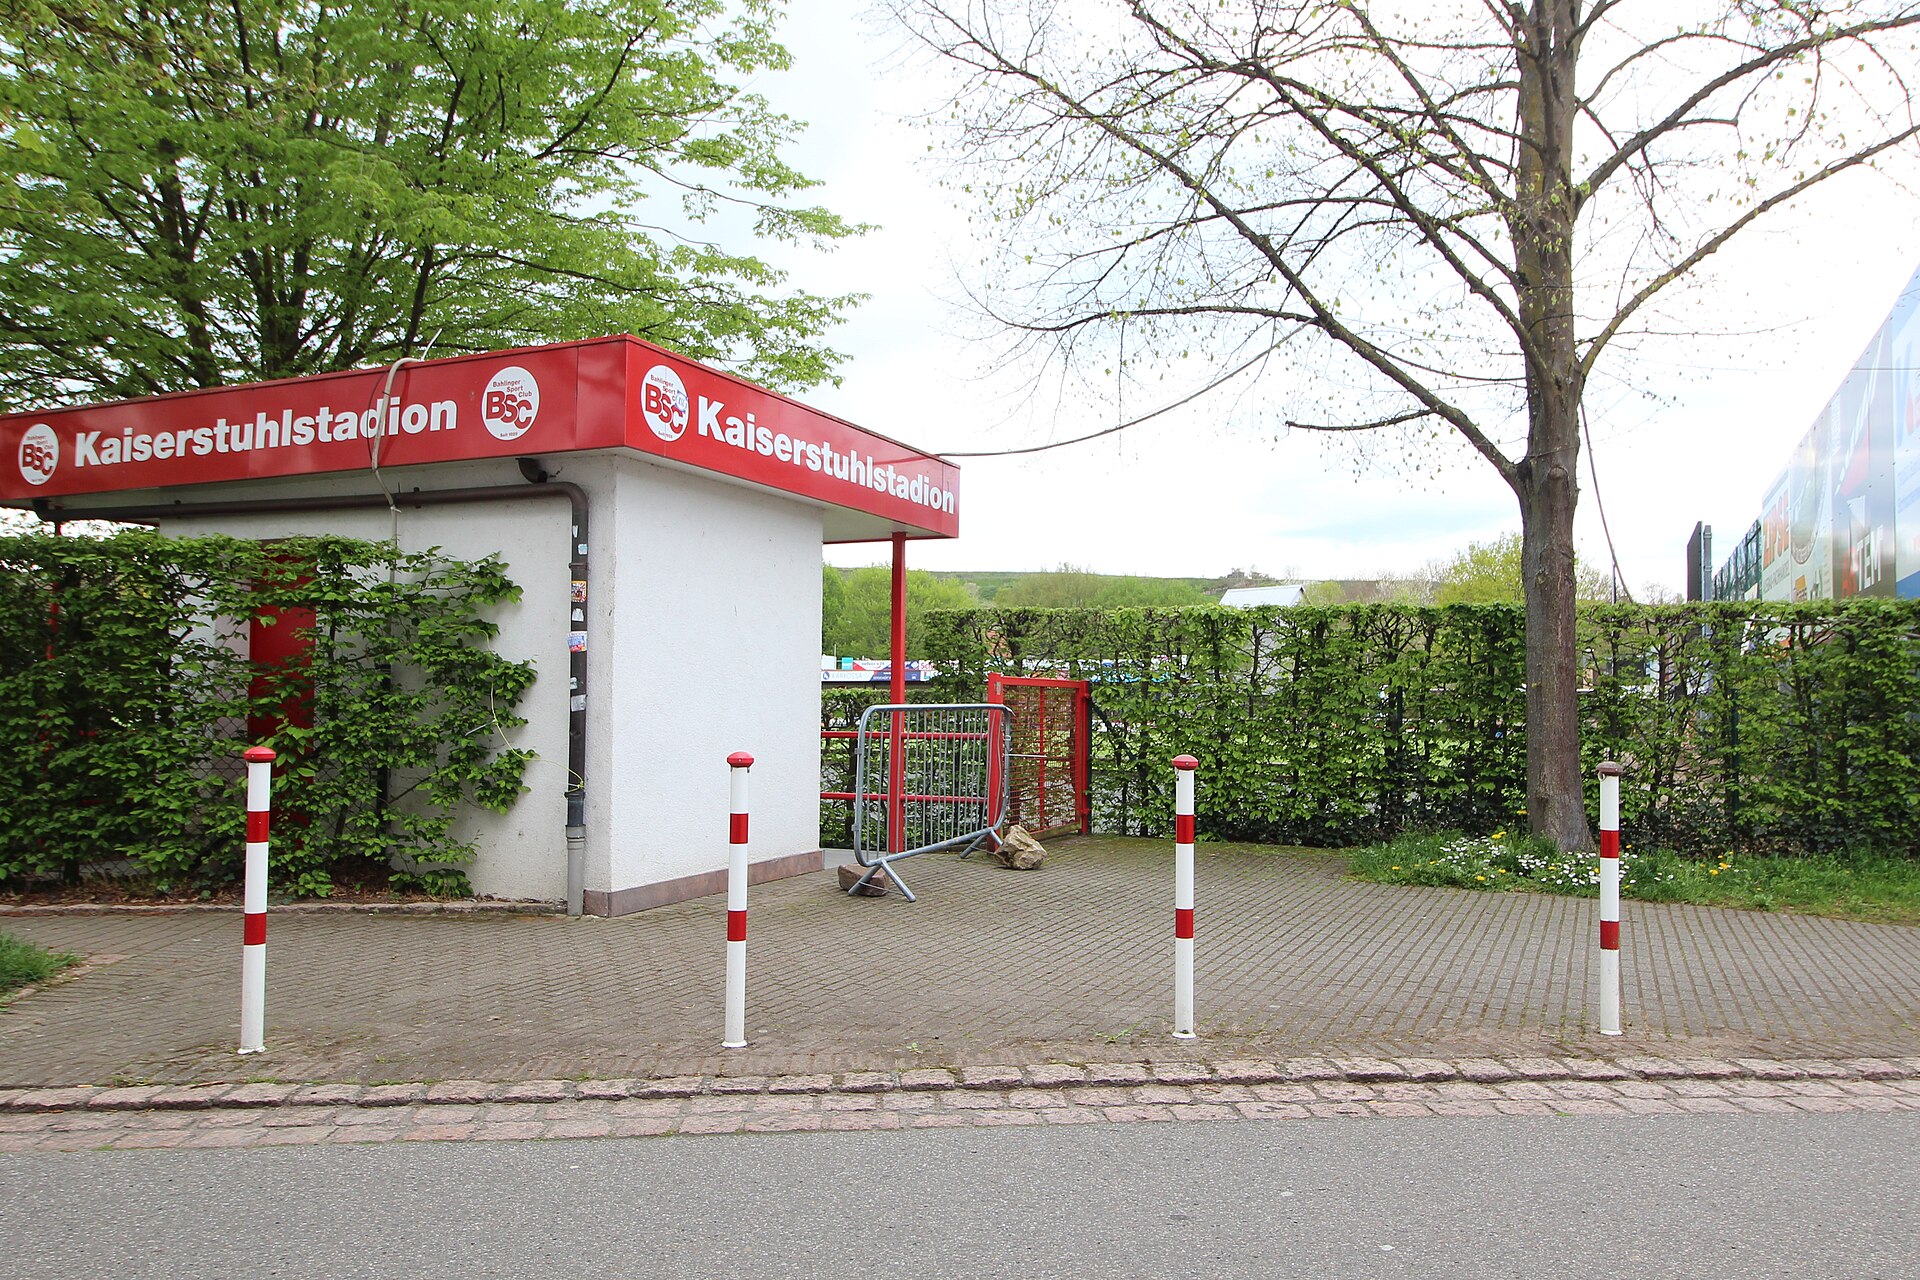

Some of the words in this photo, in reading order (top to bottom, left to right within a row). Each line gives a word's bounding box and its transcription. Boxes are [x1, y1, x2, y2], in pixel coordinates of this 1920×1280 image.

[486, 390, 533, 430] BSC
[507, 385, 523, 393] Sport
[645, 382, 684, 435] BSC
[75, 396, 458, 468] Kaiserstuhlstadion
[697, 395, 955, 514] Kaiserstuhlstadion
[22, 444, 54, 476] BSC
